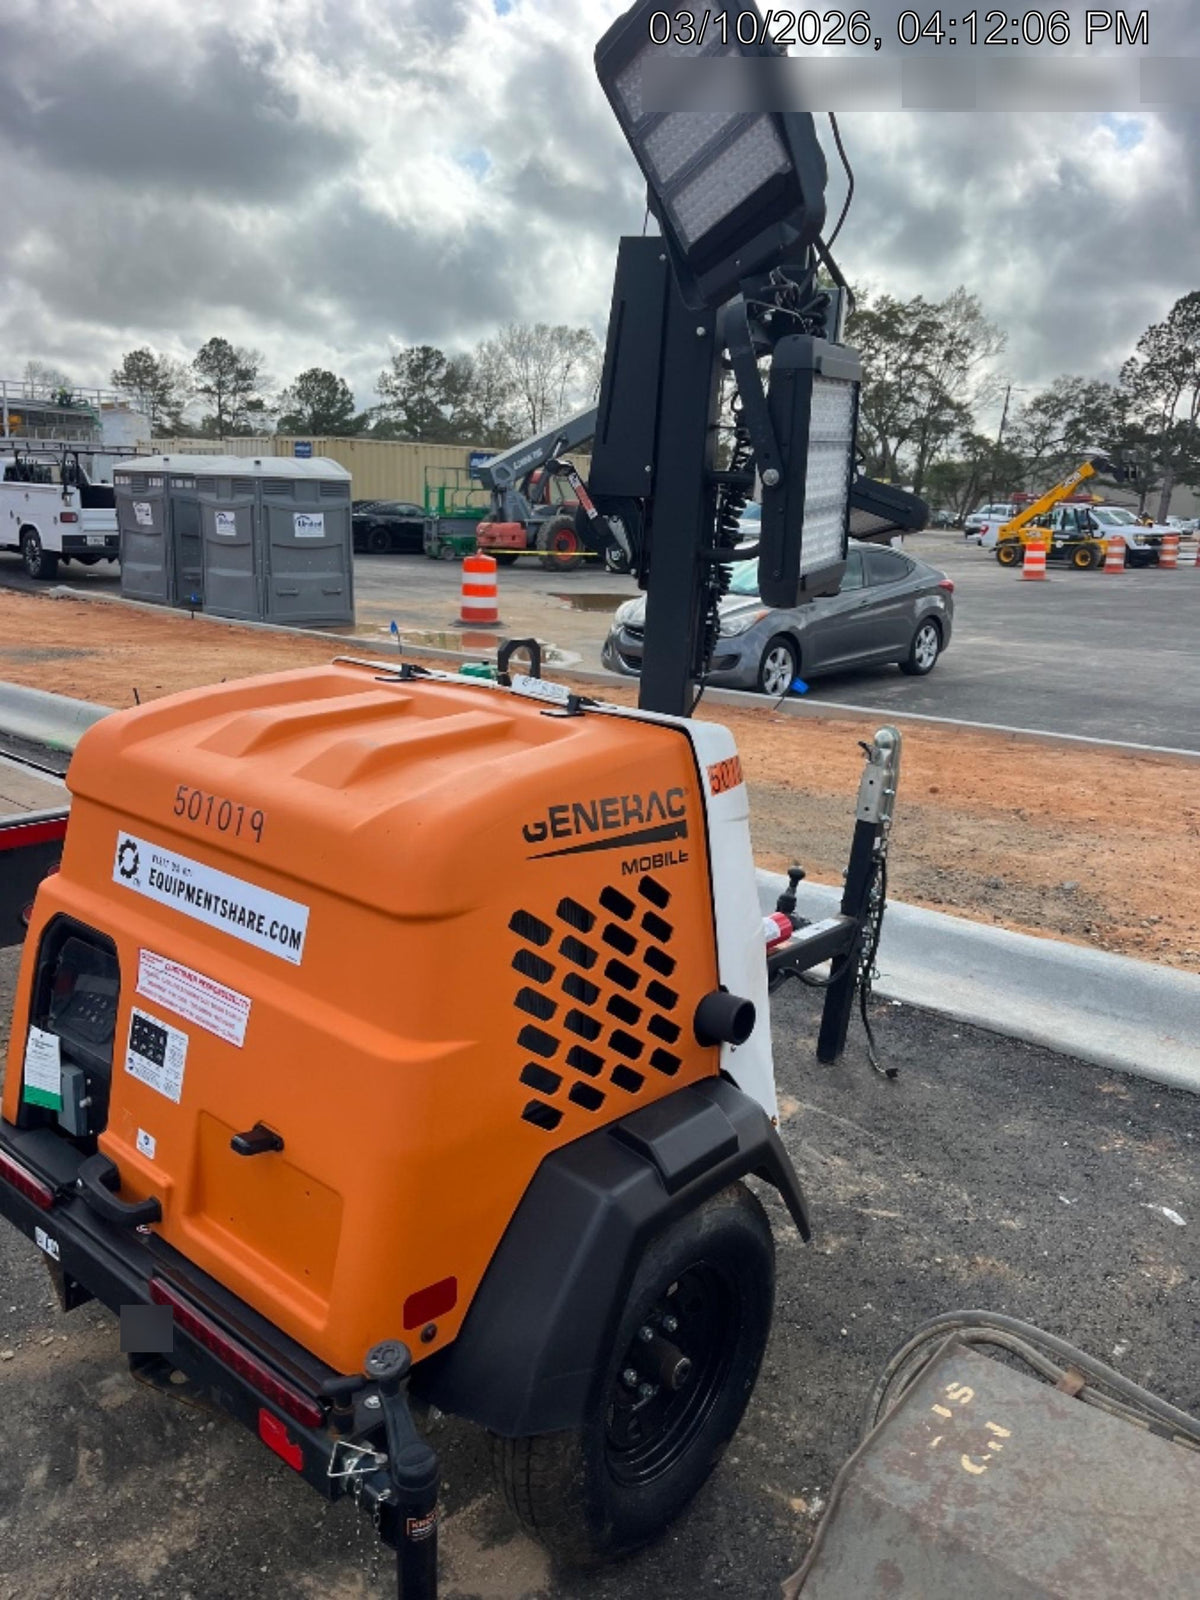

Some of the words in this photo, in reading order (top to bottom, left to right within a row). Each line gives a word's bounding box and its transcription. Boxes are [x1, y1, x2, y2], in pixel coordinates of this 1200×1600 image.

[173, 785, 264, 843] 501019
[522, 787, 686, 843] GENERAC
[621, 849, 689, 876] MOBILE
[148, 868, 302, 951] EQUIPMENTSHARE.COM
